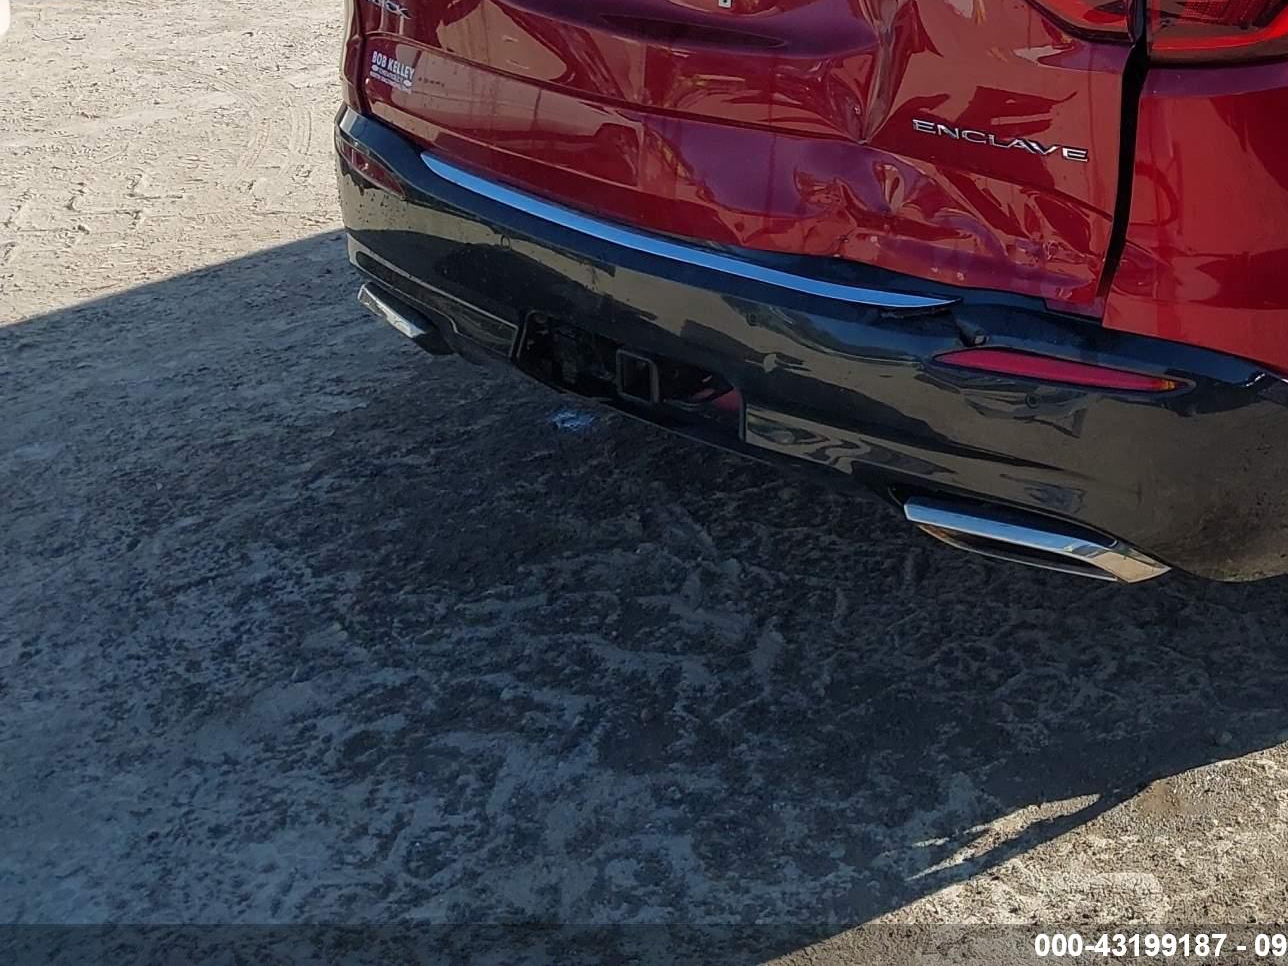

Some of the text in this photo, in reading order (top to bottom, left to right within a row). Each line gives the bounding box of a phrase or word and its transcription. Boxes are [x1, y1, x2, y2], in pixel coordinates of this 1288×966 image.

[371, 50, 415, 80] BOB KELLEY
[912, 118, 1089, 163] ENCLAVE
